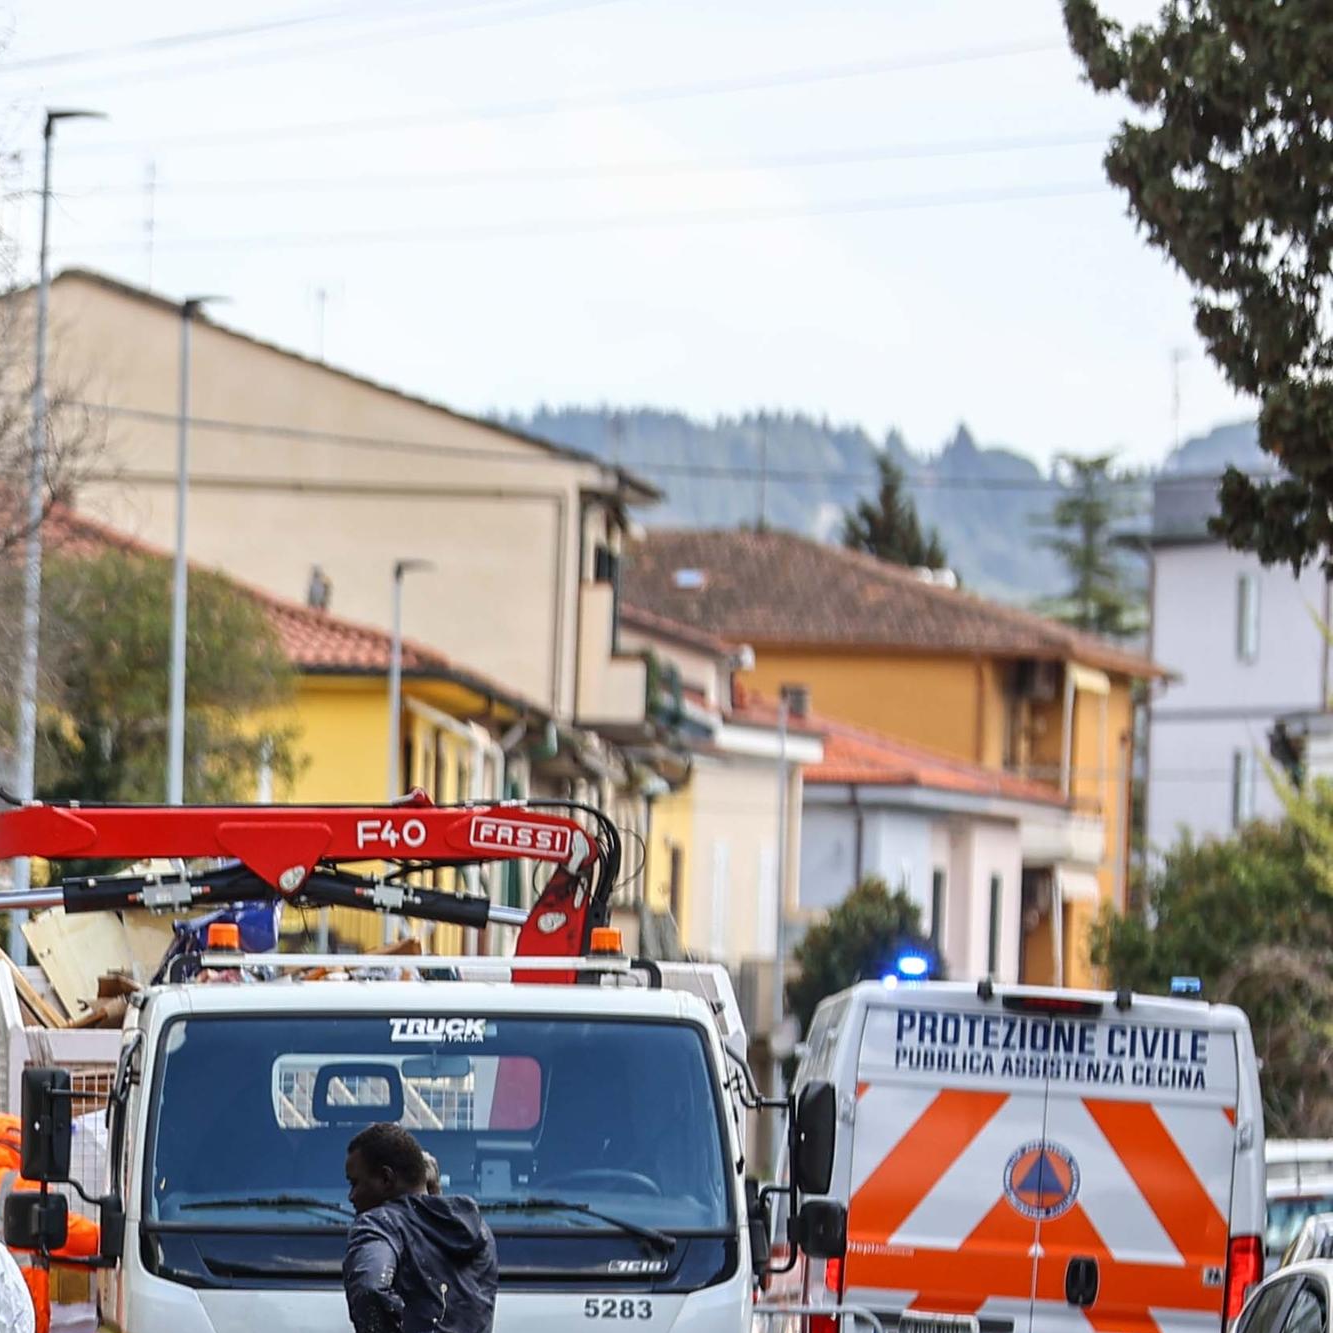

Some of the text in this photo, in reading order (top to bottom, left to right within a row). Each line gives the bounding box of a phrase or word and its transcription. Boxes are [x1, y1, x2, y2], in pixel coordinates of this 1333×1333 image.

[357, 818, 427, 850] F40
[479, 823, 562, 851] FASSI
[389, 1017, 486, 1042] TRUCK
[896, 1008, 1209, 1066] PROTEZIONE CIVILE
[895, 1047, 1207, 1091] PUBBLICA ASSISTENZA CECINA
[584, 1298, 653, 1320] 5283
